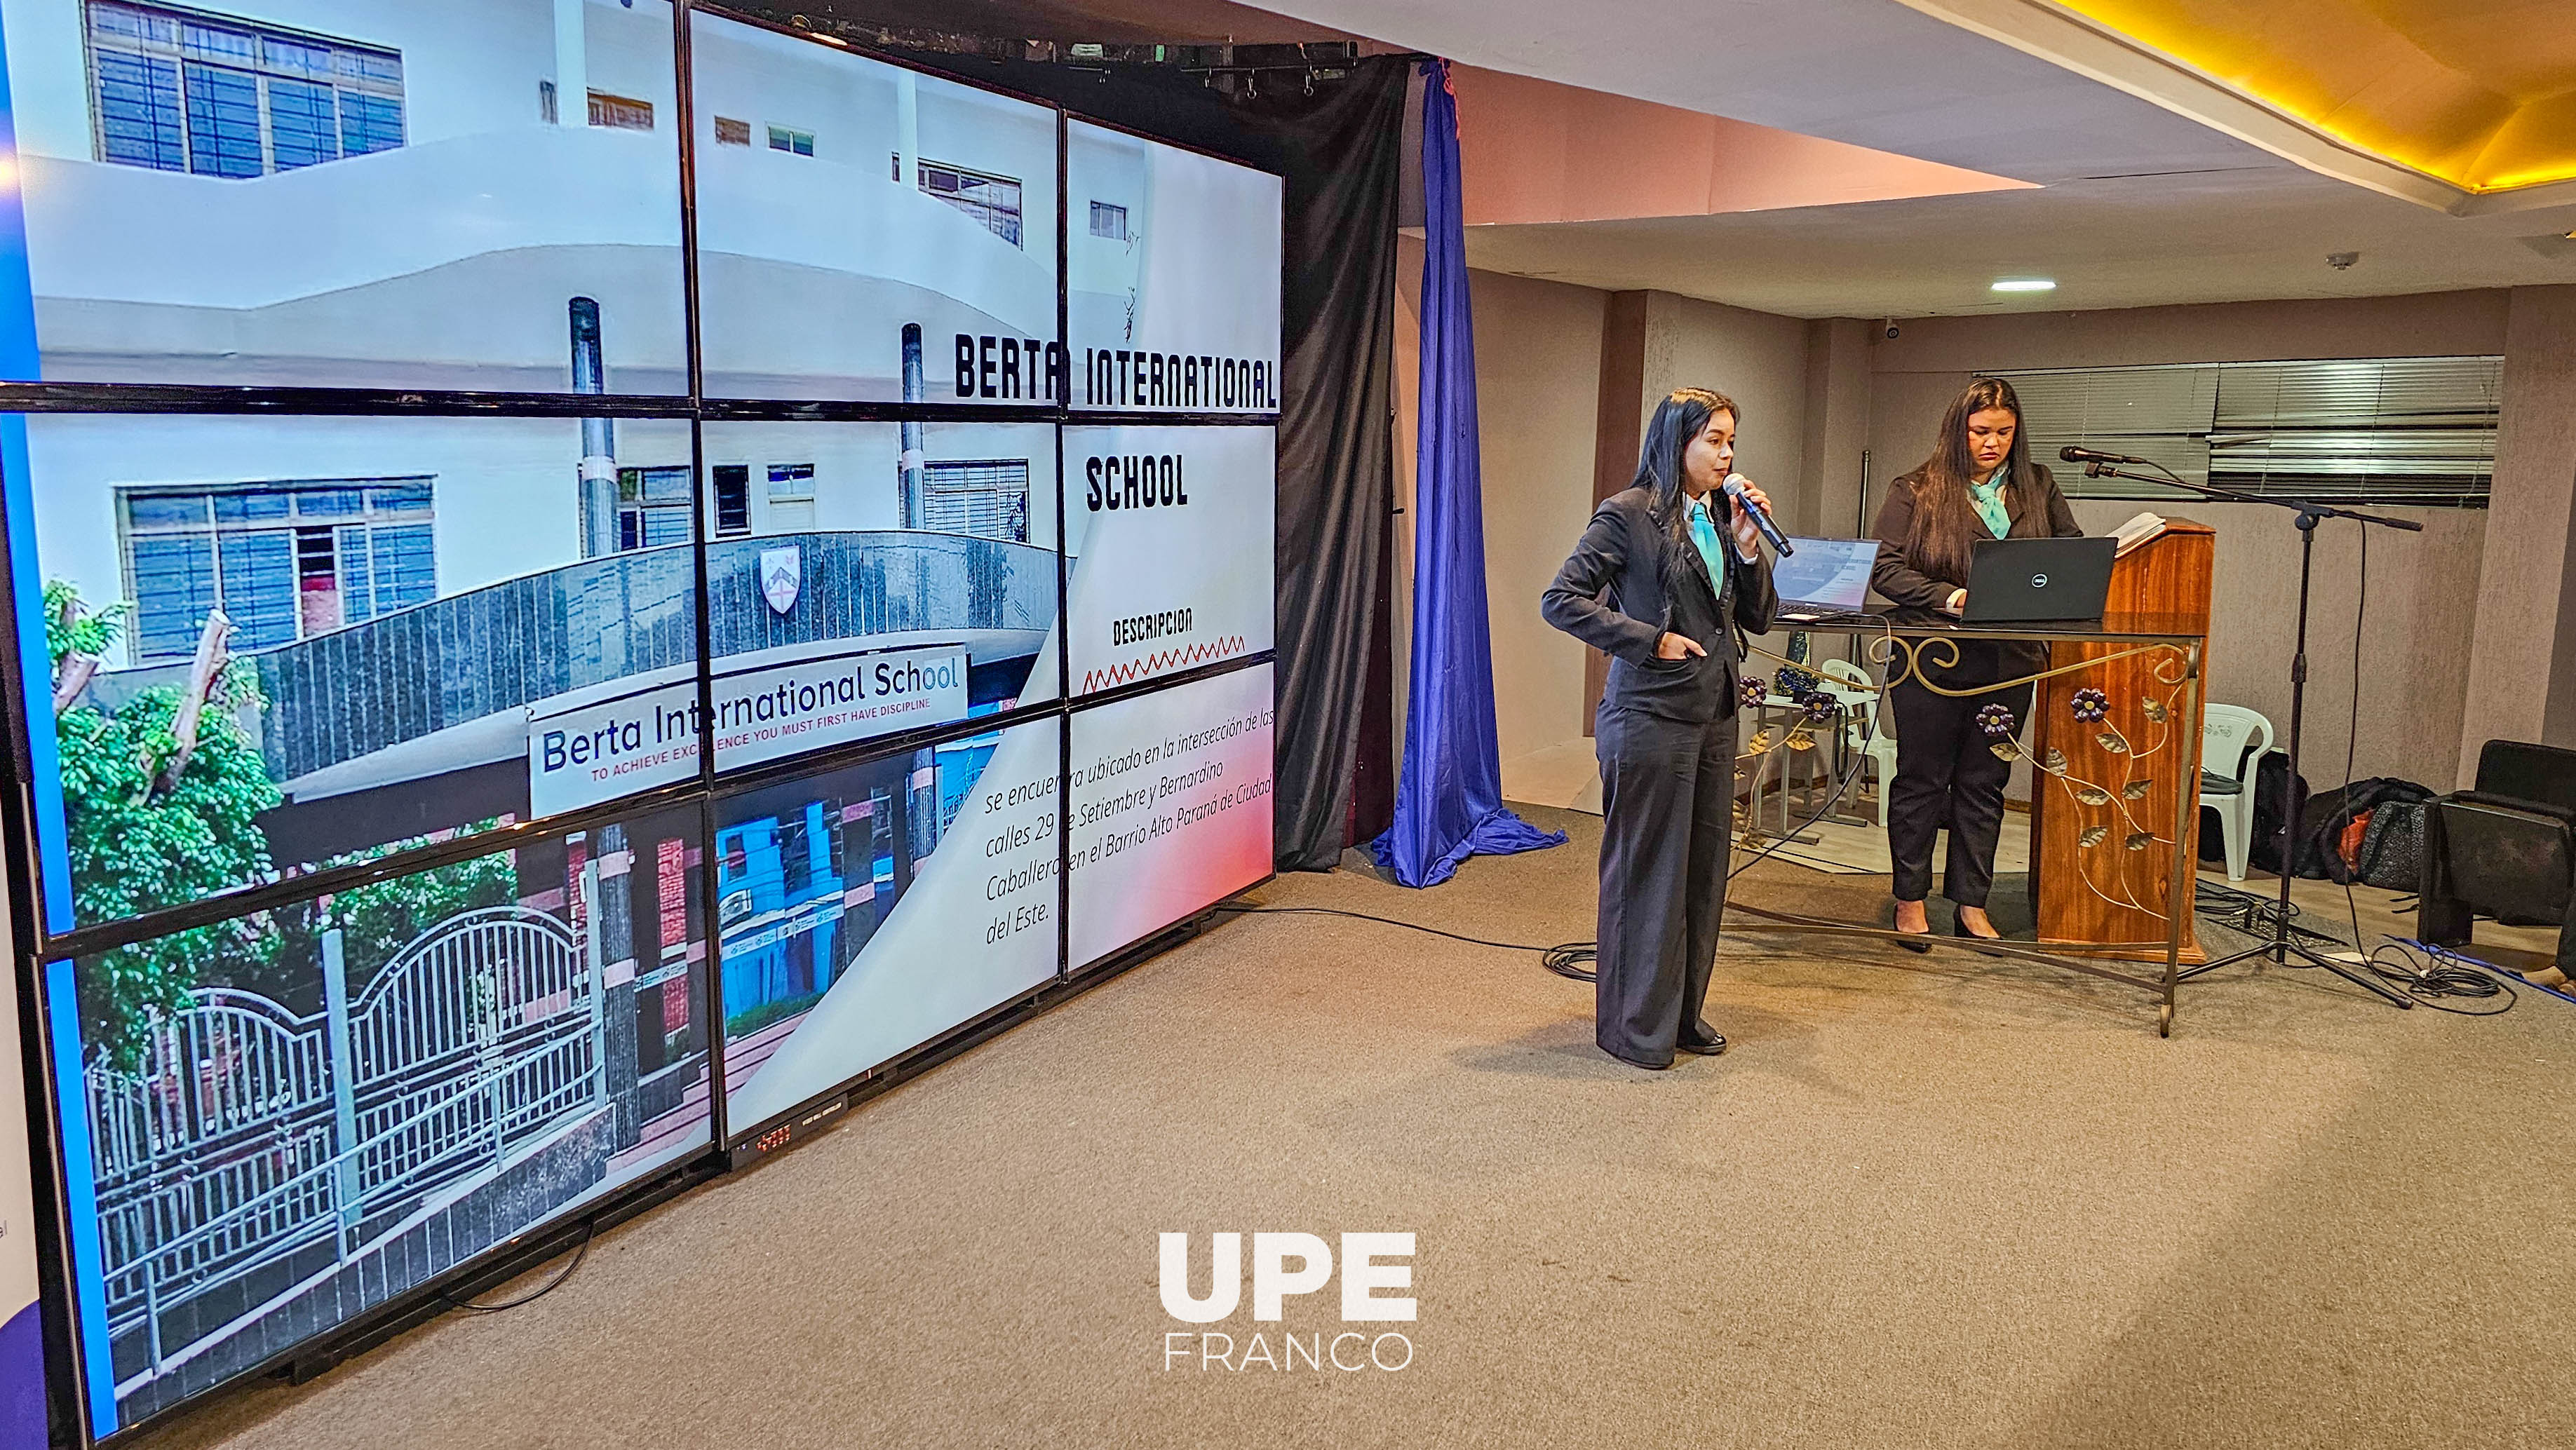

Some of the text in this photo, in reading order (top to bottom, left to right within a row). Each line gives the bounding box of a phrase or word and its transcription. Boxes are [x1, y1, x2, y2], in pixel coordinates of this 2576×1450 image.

[956, 334, 1276, 408] BERTA INTERNATIONAL
[1086, 454, 1187, 512] SCHOOL
[1113, 607, 1192, 646] DESCRIPCION
[544, 719, 641, 773] Berta
[875, 658, 958, 696] School
[591, 698, 931, 782] TO ACHIEVE EXCENCE YOU MUST FIRST HAVE DISCIPLINE
[985, 792, 1003, 814] se
[1088, 747, 1141, 784] ubicado
[1145, 746, 1159, 765] en
[1163, 737, 1175, 759] la
[1178, 717, 1242, 755] intersección
[1245, 711, 1257, 732] de
[1260, 707, 1274, 728] las
[986, 825, 1030, 858] calles
[1034, 813, 1054, 841] 29
[1079, 788, 1146, 827] Setiembre
[1147, 785, 1157, 810] y
[1159, 761, 1223, 799] Bernardino
[987, 773, 1272, 901] Caballero en el Barrio Alto Paraná de Ciudad
[987, 903, 1048, 944] del Este.
